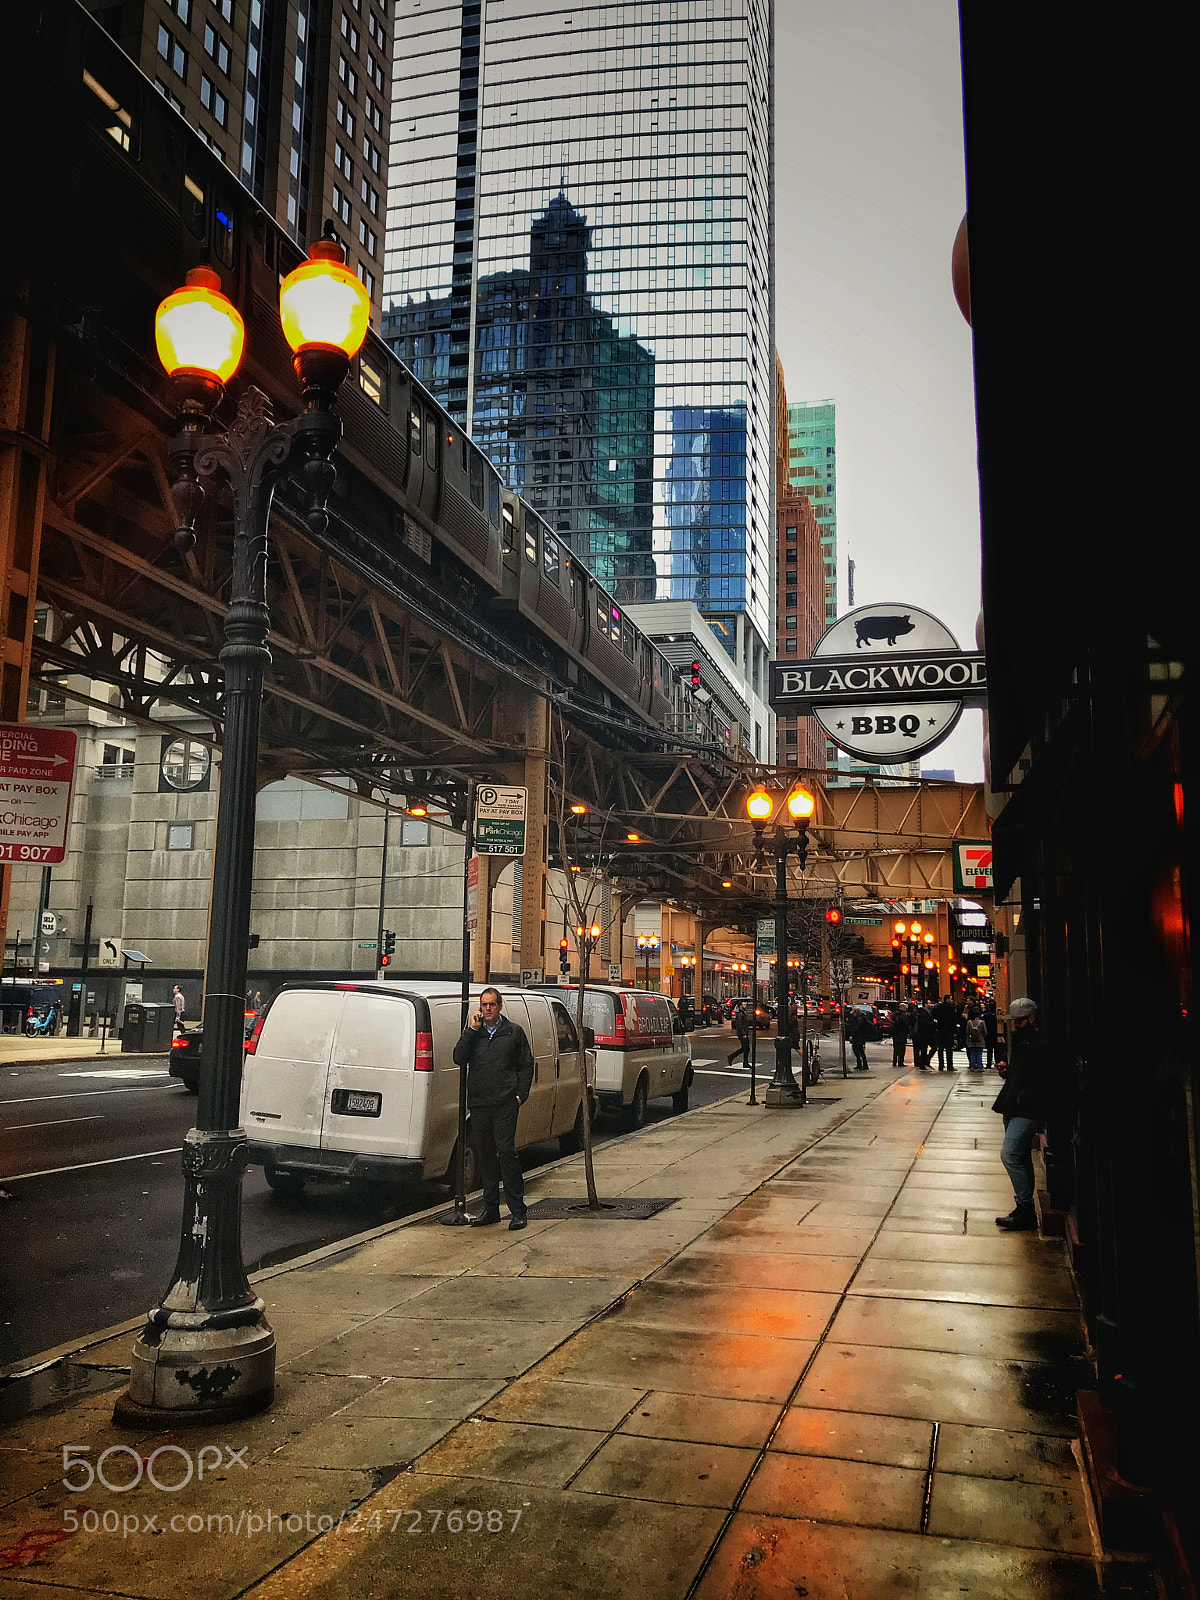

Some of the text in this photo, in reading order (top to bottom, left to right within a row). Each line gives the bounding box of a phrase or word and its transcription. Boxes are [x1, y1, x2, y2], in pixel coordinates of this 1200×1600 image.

[781, 662, 986, 693] BLACKWOOD
[851, 714, 920, 738] BBQ
[0, 730, 35, 740] ERCIAL
[0, 738, 38, 752] DING
[8, 766, 28, 775] PAID
[29, 768, 53, 777] ZONE
[13, 784, 33, 793] PAY
[35, 786, 58, 795] BOX
[20, 845, 51, 860] 907
[488, 845, 503, 853] 517
[505, 846, 518, 854] 501
[965, 850, 992, 888] 7
[956, 928, 990, 938] CHIPOTLE
[637, 1016, 670, 1033] BROADLEAF
